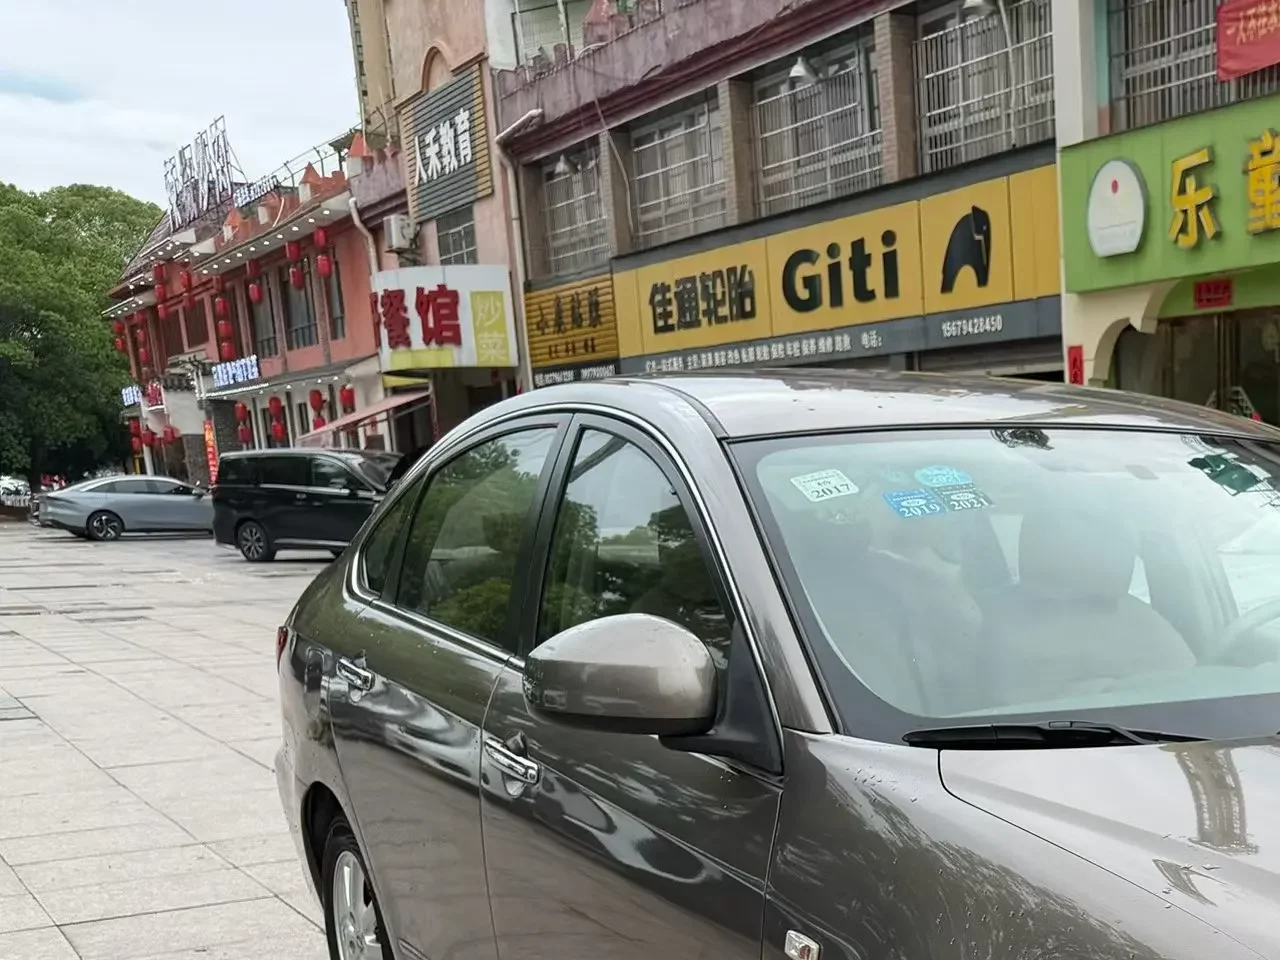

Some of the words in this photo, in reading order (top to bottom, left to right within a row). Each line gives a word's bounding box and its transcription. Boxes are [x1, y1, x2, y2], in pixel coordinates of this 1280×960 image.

[414, 107, 472, 186] 人禾教育
[649, 264, 756, 335] 佳通轮胎
[782, 229, 900, 313] Giti
[370, 283, 462, 349] 餐馆
[475, 295, 508, 362] 炒菜
[811, 483, 850, 498] 2017
[899, 503, 941, 518] 2019
[950, 497, 989, 510] 2021
